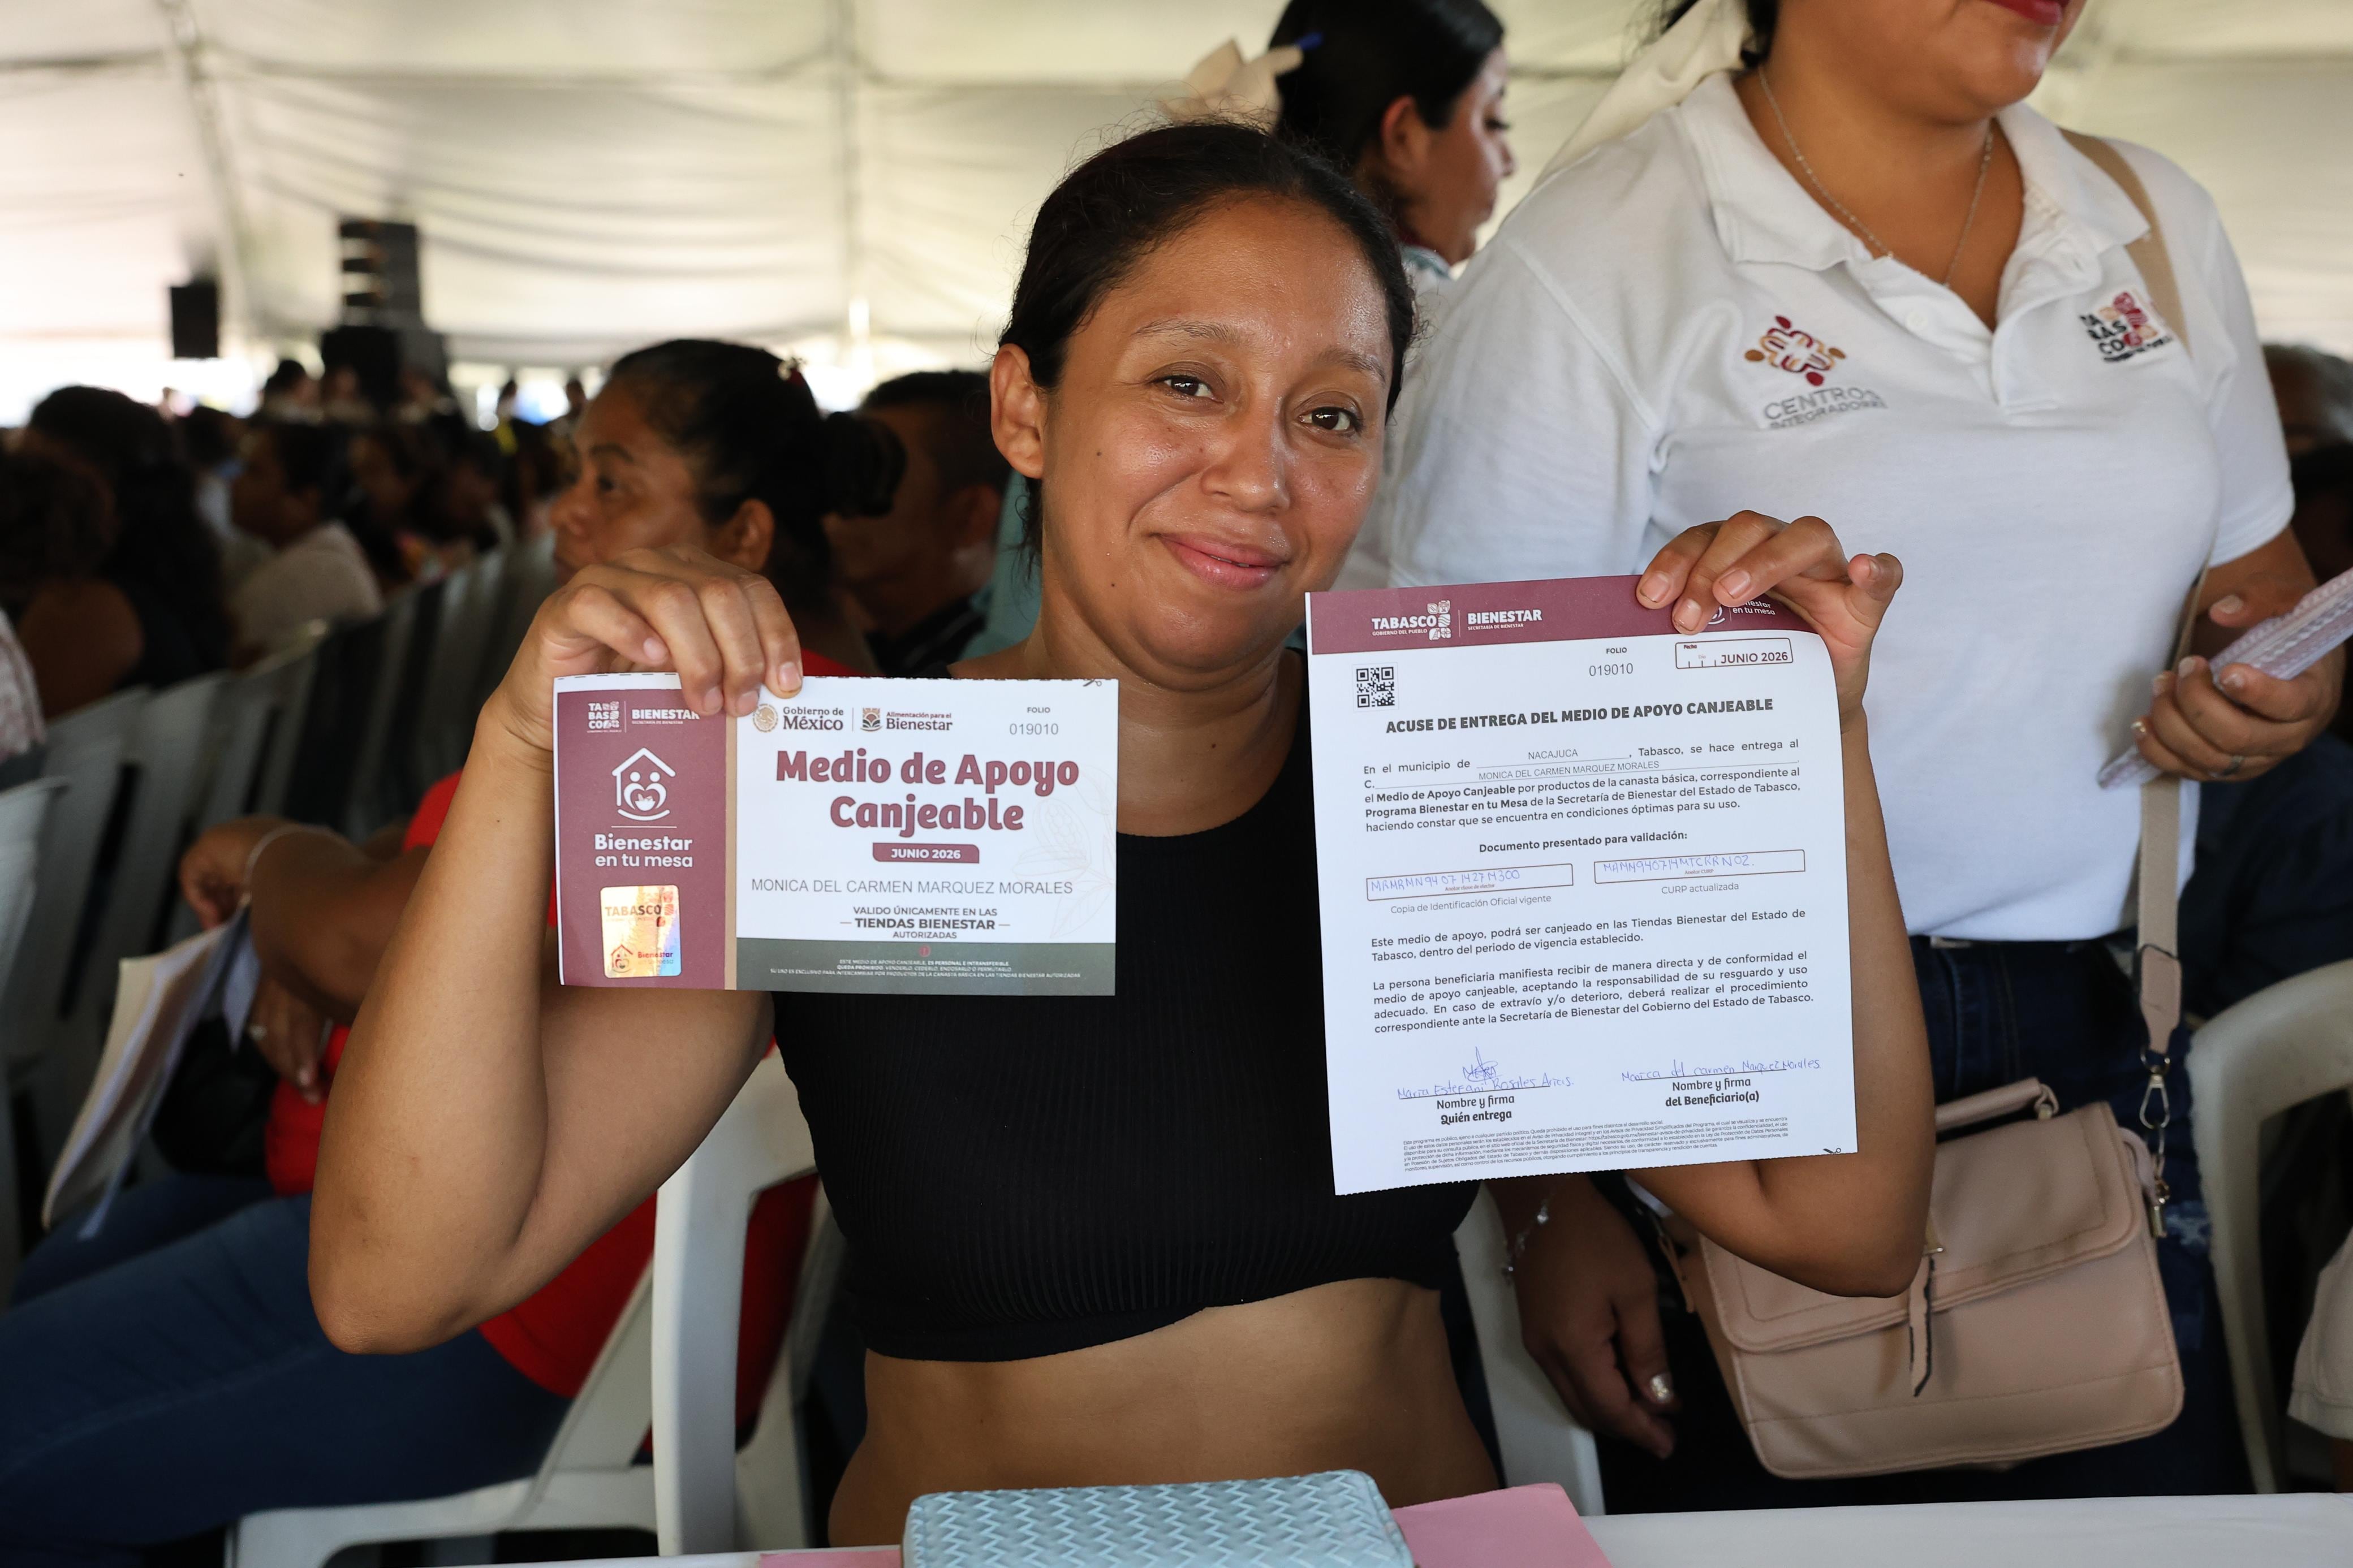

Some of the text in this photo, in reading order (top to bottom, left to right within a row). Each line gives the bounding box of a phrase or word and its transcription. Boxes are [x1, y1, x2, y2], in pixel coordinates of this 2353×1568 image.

[1371, 615, 1437, 630] TABASCO
[1467, 609, 1542, 625] BIENESTAR
[1721, 651, 1788, 664] JUNIO 2026
[1589, 663, 1634, 677] 019010
[588, 711, 609, 720] BAS
[632, 709, 700, 720] BIENESTAR
[783, 706, 844, 716] Gobierno de
[1386, 698, 1773, 733] ACUSE DE ENTREGA DEL MEDIO DE APOYO CANJEABLE
[783, 715, 844, 731] México
[886, 718, 953, 731] Bienestar
[1009, 723, 1059, 735] 019010
[1364, 766, 1376, 774] En
[1382, 763, 1391, 773] el
[1398, 760, 1451, 772] municipio
[1456, 759, 1471, 768] de
[1528, 749, 1578, 760] NACAJUCA
[1637, 746, 1684, 757] Tabasco,
[1709, 743, 1735, 753] hace
[1741, 741, 1783, 751] entrega
[1790, 738, 1799, 748] al
[776, 748, 1079, 797] Medio de Apoyo
[1364, 761, 1660, 789] C. MONICA DEL CARMEN MARQUEZ MORALES
[830, 793, 1024, 838] Canjeable
[594, 833, 693, 850] Bienestar
[1479, 830, 1687, 853] Documento presentado para validación:
[595, 853, 693, 867] en tu mesa
[891, 848, 961, 859] JUNIO 2026
[752, 878, 1073, 895] MONICA DEL CARMEN MARQUEZ MORALES
[1661, 882, 1739, 895] CURP actualizada
[605, 905, 662, 917] TABASCO
[853, 906, 891, 915] VALIDO
[893, 905, 960, 916] ÚNICAMENTE
[979, 908, 998, 917] LAS
[1390, 904, 1415, 914] Copia
[1430, 899, 1489, 910] Identificación
[1490, 896, 1518, 906] Oficial
[1519, 895, 1552, 905] vigente
[855, 918, 996, 930] TIENDAS BIENESTAR
[893, 931, 957, 939] AUTORIZADAS
[1371, 932, 1643, 961] Tabasco, dentro del periodo de vigencia establecido.
[1672, 1078, 1751, 1092] Nombre y firma
[1437, 1095, 1515, 1109] Nombre y firma
[1665, 1090, 1760, 1107] del Beneficiario(a)
[1441, 1111, 1512, 1125] Quién entrega
